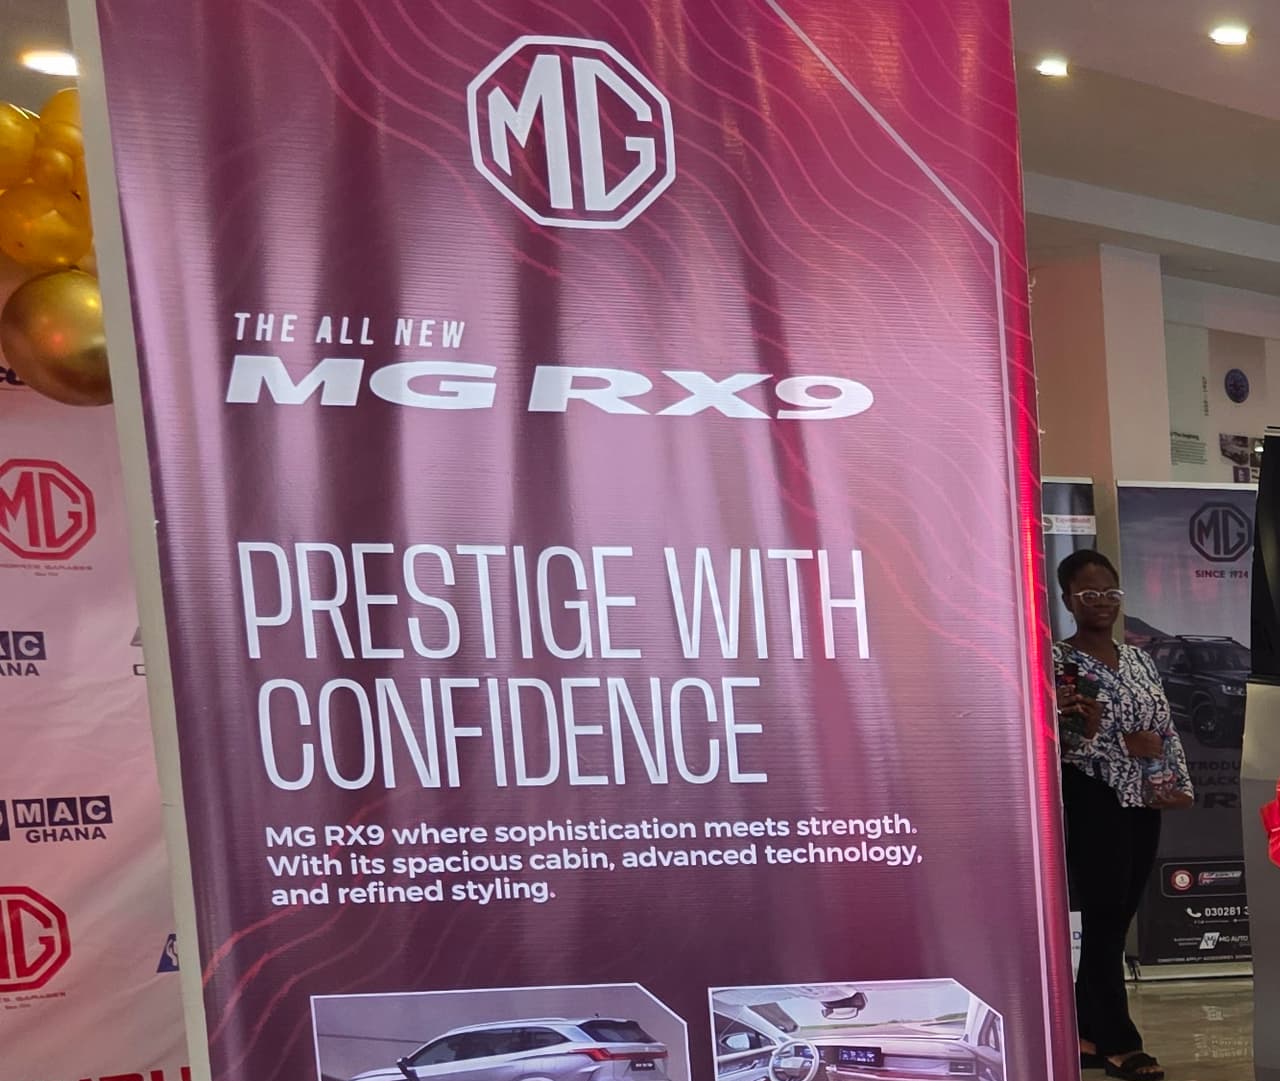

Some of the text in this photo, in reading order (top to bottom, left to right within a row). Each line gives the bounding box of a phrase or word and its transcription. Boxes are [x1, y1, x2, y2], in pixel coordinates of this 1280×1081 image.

[487, 54, 656, 211] MG
[234, 312, 467, 348] THE ALL NEW
[226, 354, 874, 420] MG RX9
[1197, 509, 1246, 556] MG
[1194, 569, 1226, 579] SINCE
[237, 542, 871, 660] PRESTIGE WITH
[257, 676, 768, 791] CONFIDENCE
[25, 826, 107, 844] GHANA
[265, 813, 918, 847] MG RX9 where sophistication meets strength.
[266, 841, 923, 878] With its spacious cabin, advanced technology,
[271, 877, 556, 906] and refined styling.
